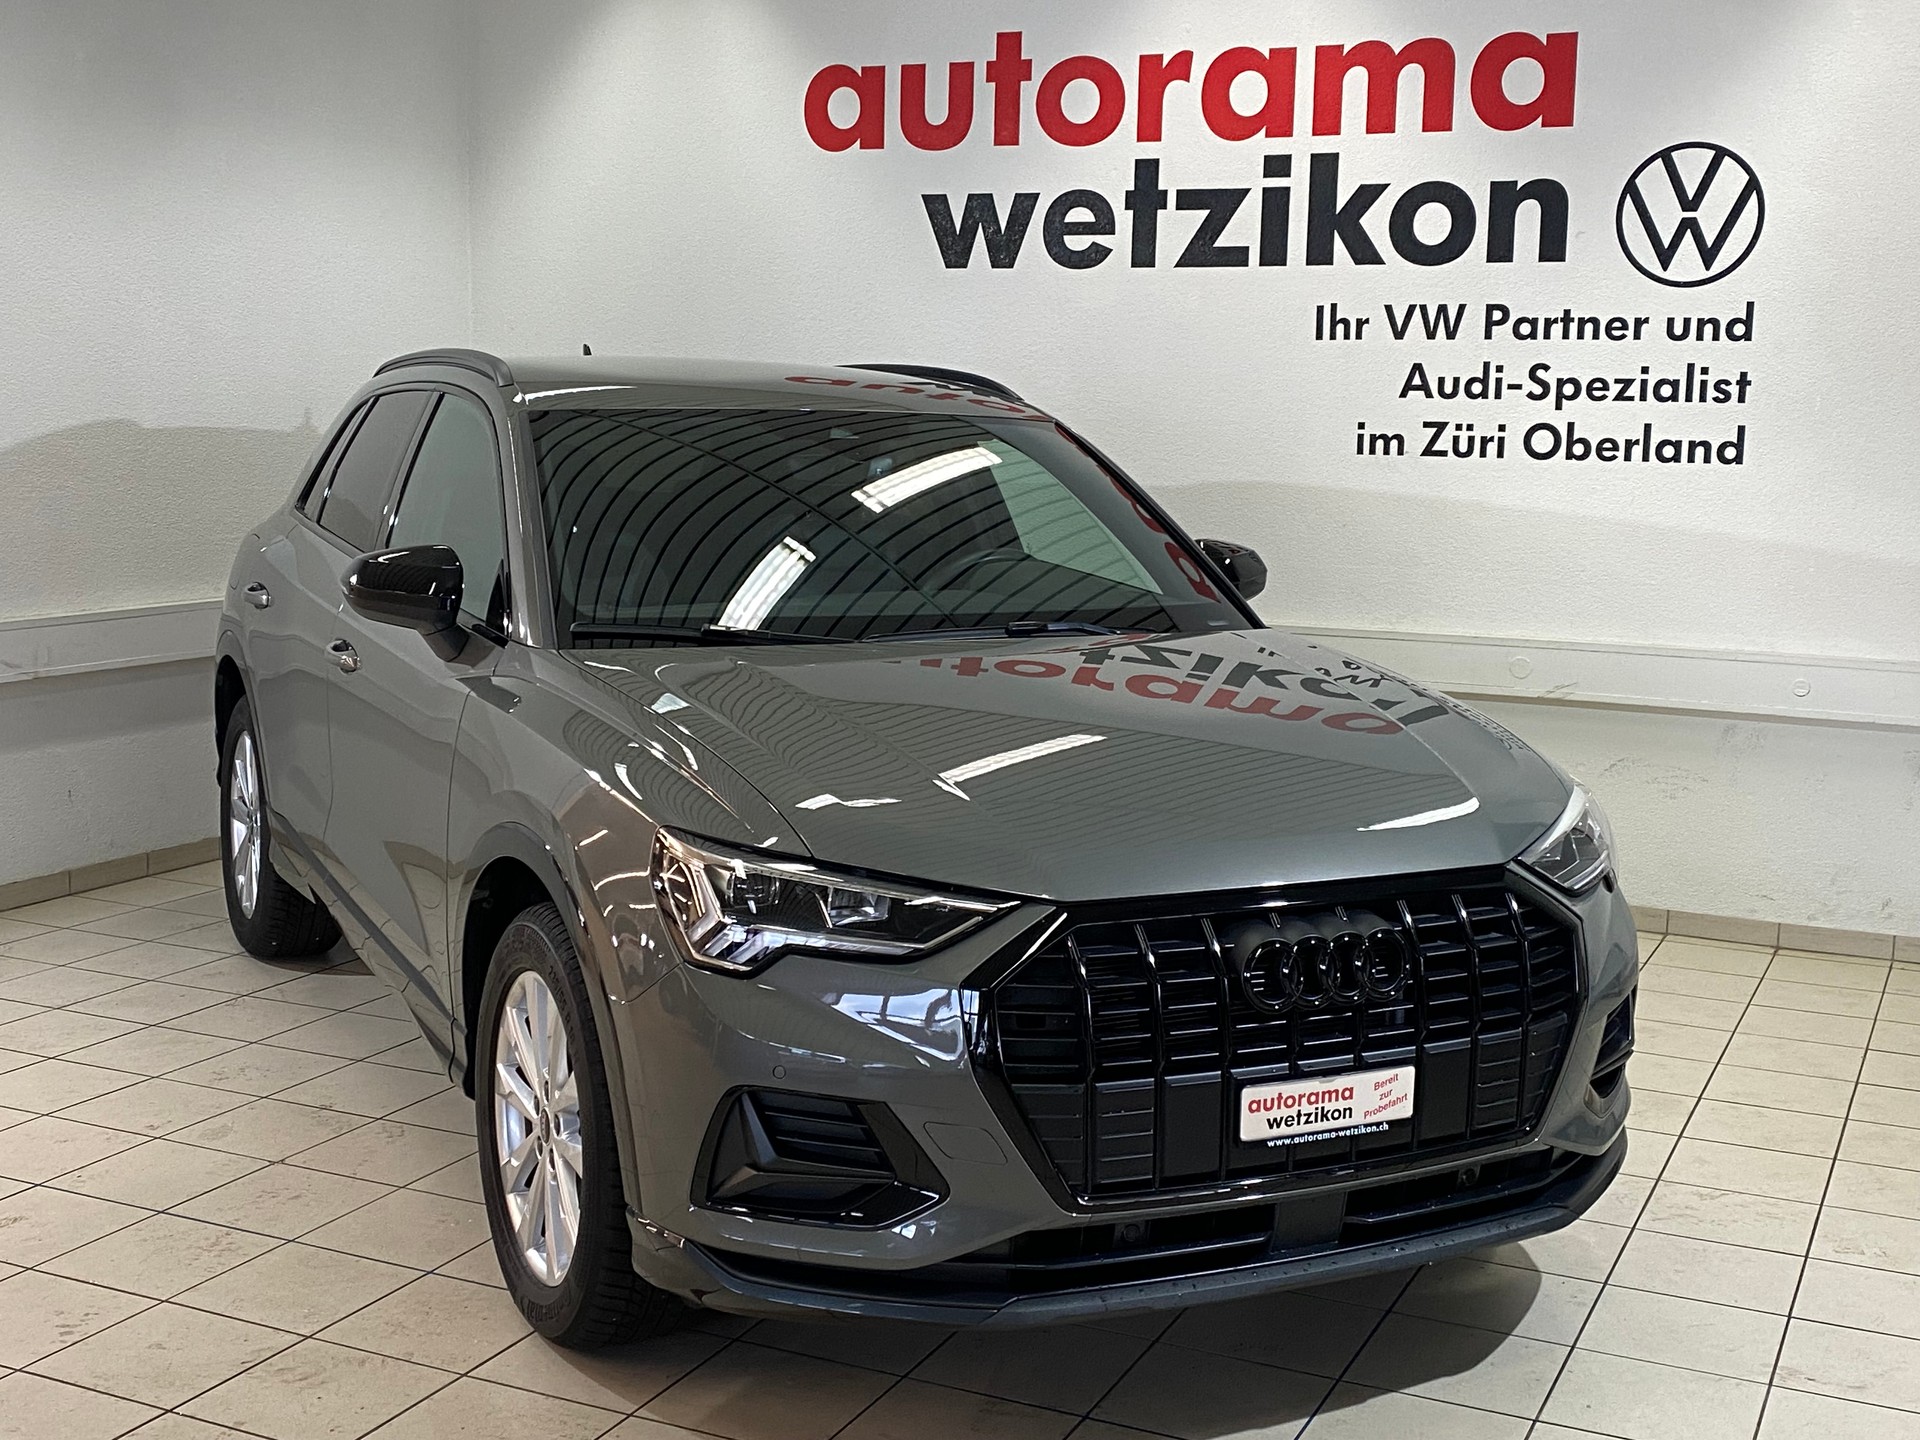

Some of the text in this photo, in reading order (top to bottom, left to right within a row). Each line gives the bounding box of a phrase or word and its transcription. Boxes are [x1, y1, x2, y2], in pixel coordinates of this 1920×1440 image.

[803, 31, 1579, 152] autorama
[920, 152, 1569, 270] wetzikon
[1315, 301, 1755, 342] Ihr VW Partner und
[1398, 360, 1752, 411] Audi-Spezialist
[1356, 420, 1746, 465] im Züri Oberland
[1373, 1072, 1400, 1092] Bereit
[1378, 1088, 1394, 1102] zur
[1247, 1086, 1355, 1115] autorama
[1363, 1092, 1409, 1120] Probefahrt
[1266, 1105, 1353, 1131] wetzikon
[1266, 1121, 1390, 1148] www.autorama-wetzikon.ch
